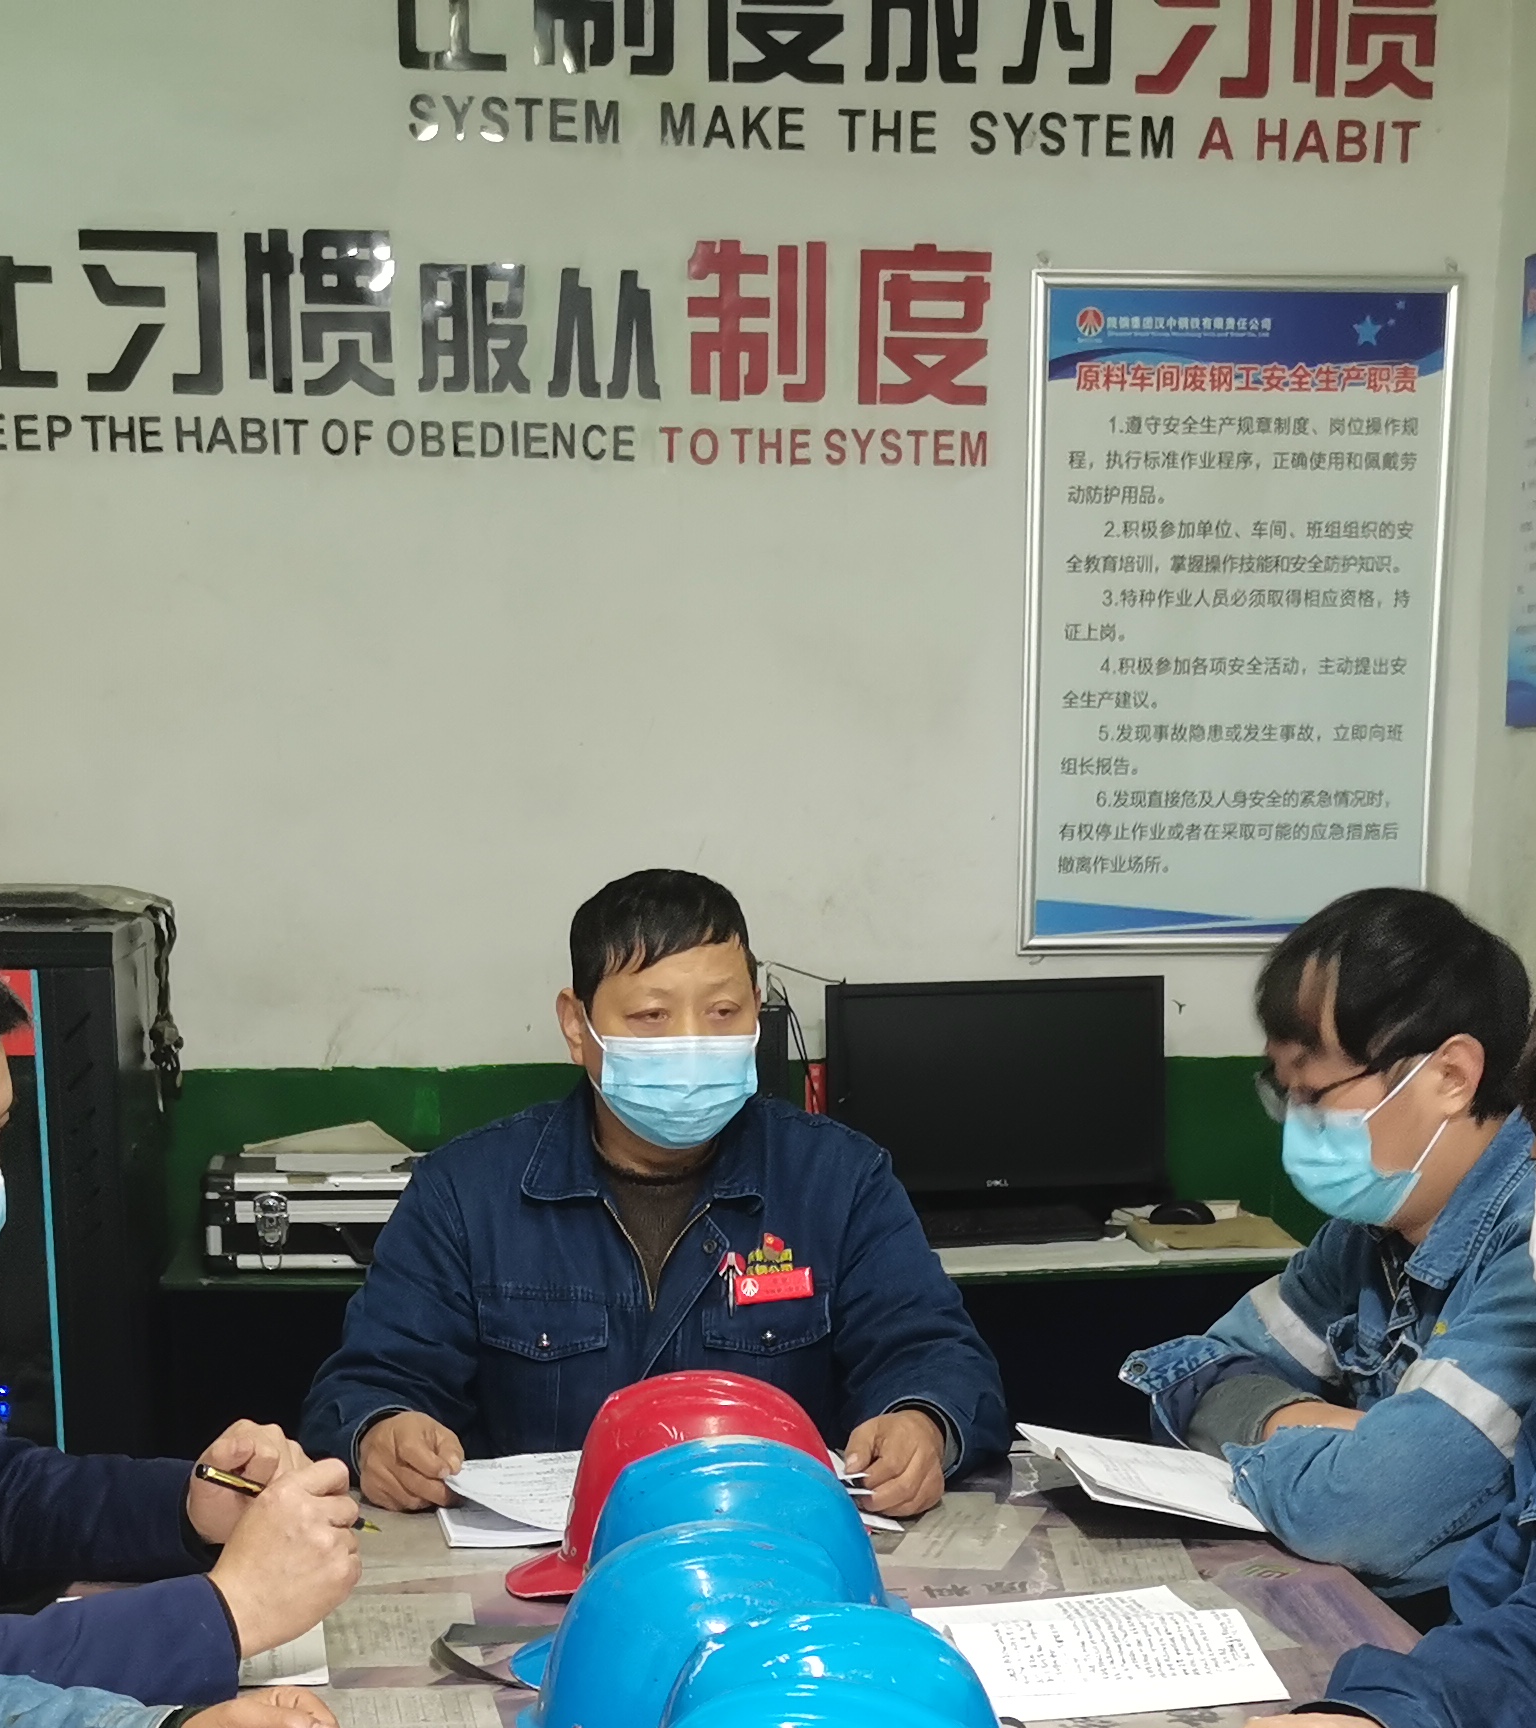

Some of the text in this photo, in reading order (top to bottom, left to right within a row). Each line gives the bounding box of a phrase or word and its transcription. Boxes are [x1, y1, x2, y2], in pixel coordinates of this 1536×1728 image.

[408, 94, 1421, 165] SYSTEM MAKE THE SYSTEM A HABIT
[1076, 362, 1419, 393] 原料车间废钢工安全生产职责
[1108, 416, 1419, 436] 1.遵守安全生产规章制度、岗位操作规
[81, 415, 163, 454] THE
[173, 416, 309, 456] HABIT
[320, 417, 374, 458] OF
[386, 419, 636, 462] OBEDIENCE
[660, 426, 719, 465] TO
[730, 427, 812, 466] THE
[823, 428, 988, 468] SYSTEM
[1068, 485, 1165, 505] 动防护用品。
[1104, 520, 1414, 541] 2.积极参加单位、车间、班组组织的安
[1102, 588, 1410, 609] 3.特种作业人员必须取得相应资格，持
[1064, 623, 1125, 643] 证上岗。
[1100, 657, 1407, 677] 4.积极参加各项安全活动，主动提出安
[1062, 690, 1158, 710] 全生产建议。
[1098, 724, 1403, 743] 5.发现事故隐患或发生事故，立即向班
[1060, 756, 1140, 776] 组长报告。
